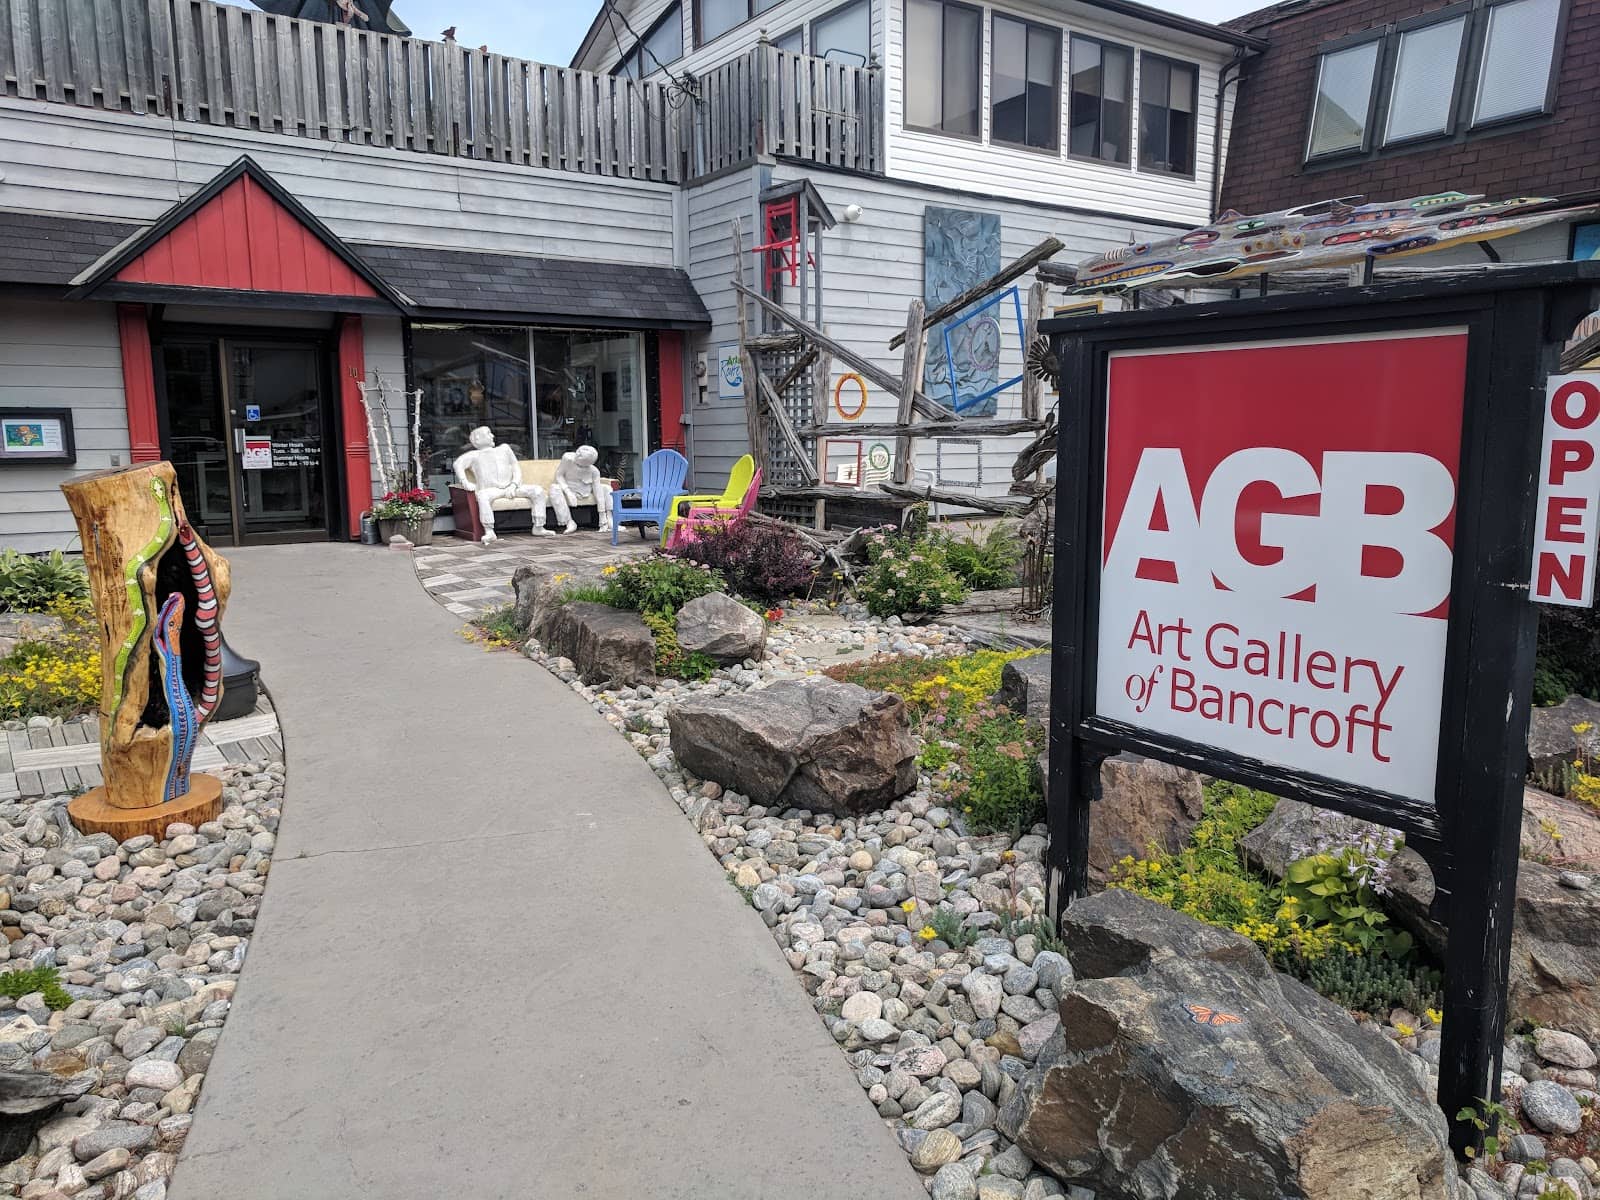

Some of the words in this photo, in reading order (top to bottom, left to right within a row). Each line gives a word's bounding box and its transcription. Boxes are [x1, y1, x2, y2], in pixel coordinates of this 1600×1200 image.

[243, 447, 271, 459] AGB
[1536, 380, 1600, 600] OPEN
[1102, 447, 1456, 617] AGB
[1125, 664, 1163, 713] of
[1170, 667, 1393, 763] Bancroft
[1127, 610, 1193, 662] Art
[1205, 622, 1405, 716] Gallery
